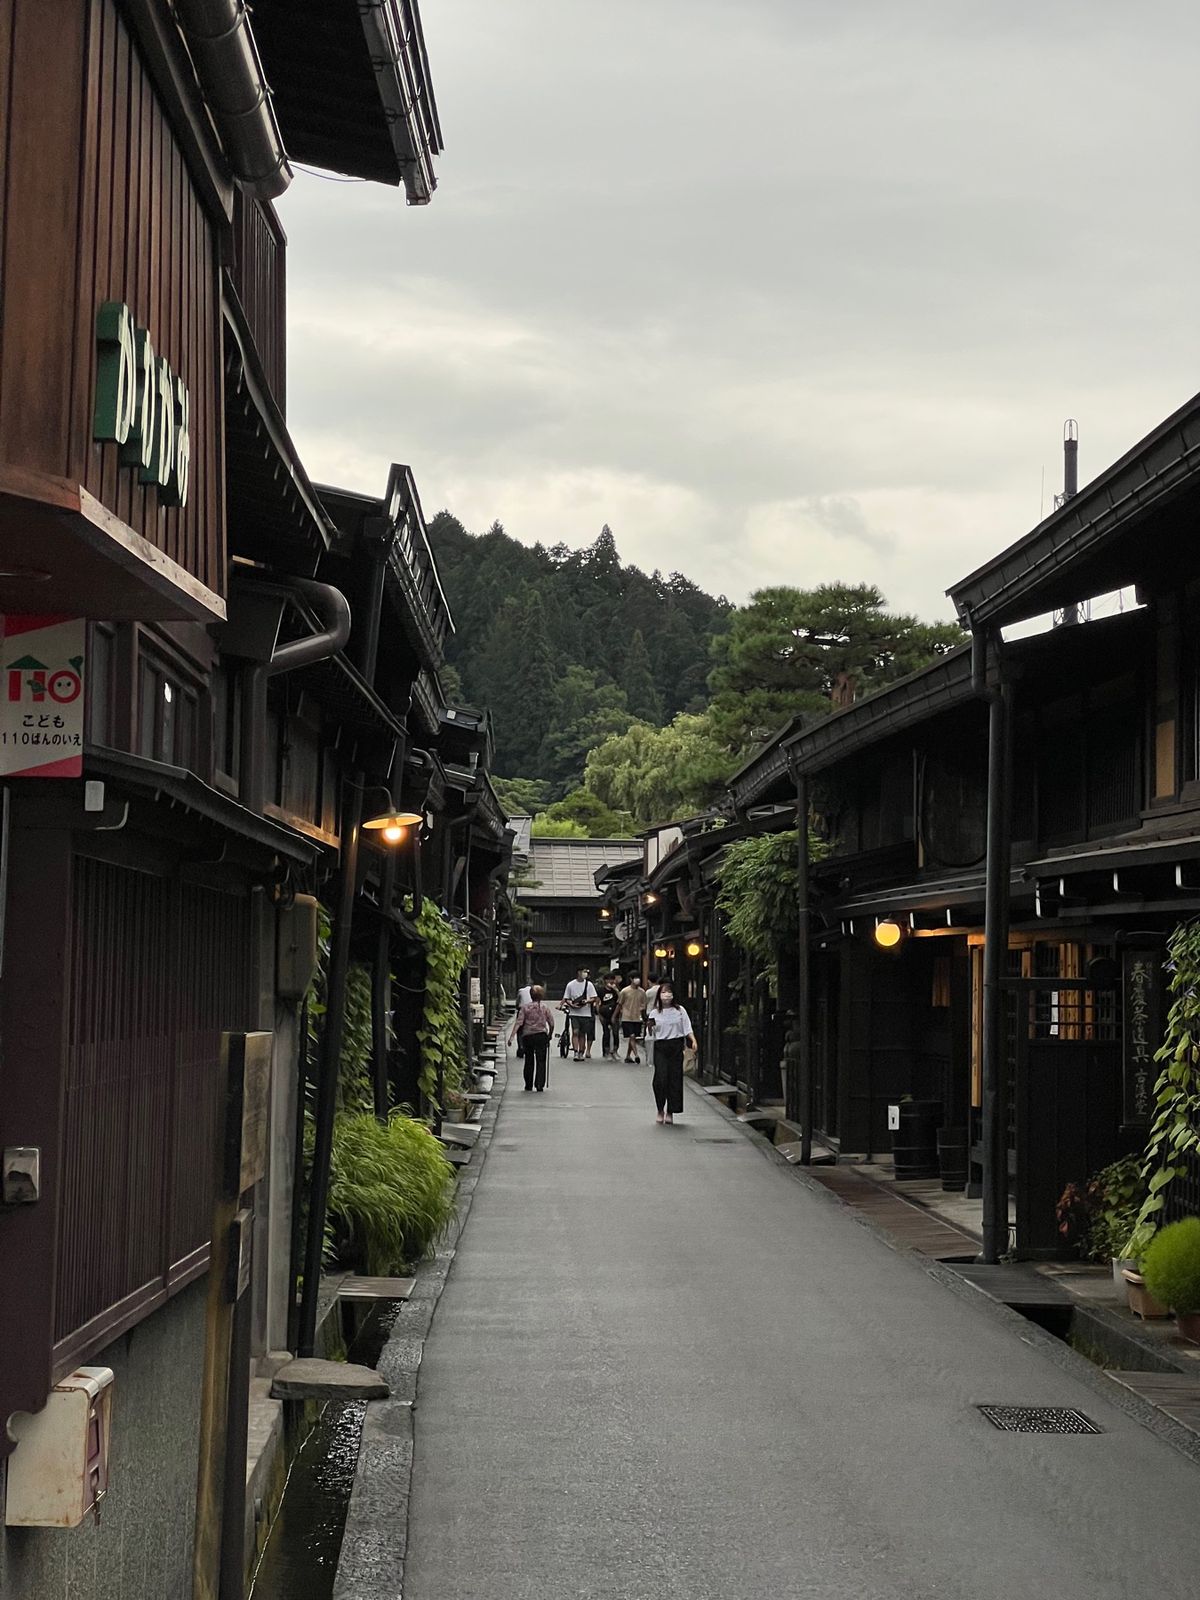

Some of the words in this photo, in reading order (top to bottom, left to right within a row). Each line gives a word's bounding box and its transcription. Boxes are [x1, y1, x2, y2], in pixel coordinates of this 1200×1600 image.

[22, 714, 65, 729] こども
[2, 731, 82, 747] 110ばんのいえ
